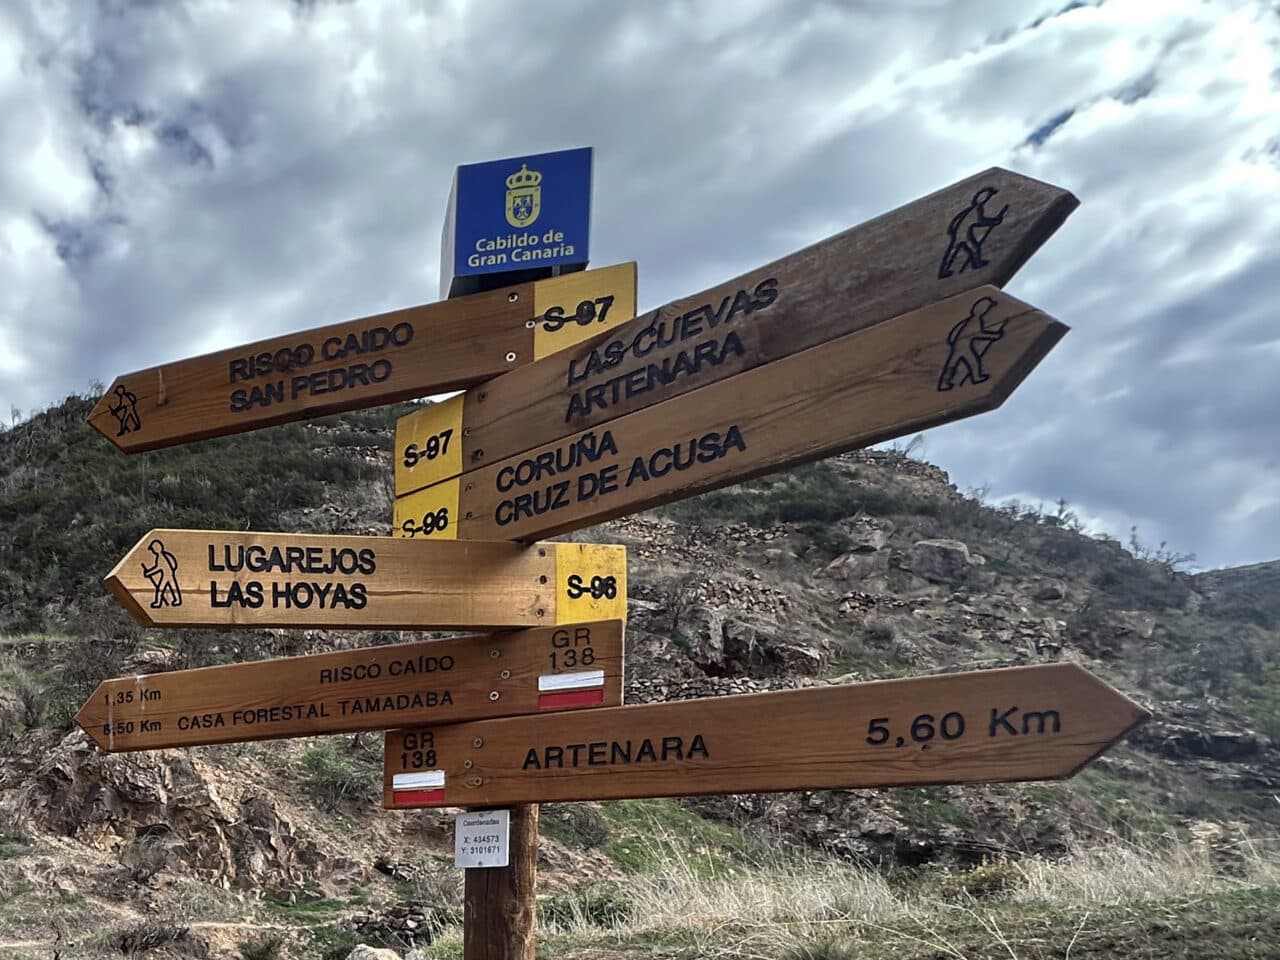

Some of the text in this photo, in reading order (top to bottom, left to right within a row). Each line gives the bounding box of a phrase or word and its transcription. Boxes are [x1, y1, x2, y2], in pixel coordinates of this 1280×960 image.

[468, 244, 574, 267] Gran Canaria
[476, 229, 564, 252] Cabildo de
[568, 278, 778, 387] LAS CUEVAS
[229, 322, 414, 384] RISCO CAIDO
[230, 359, 393, 413] SAN PEDRO
[565, 330, 744, 423] ARTENARA
[404, 429, 453, 468] S-97
[496, 430, 618, 493] CORUÑA
[495, 425, 746, 526] CRUZ DE ACUSA
[208, 544, 376, 575] LUGAREJOS
[210, 580, 368, 609] LAS HOYAS
[567, 575, 617, 599] S-96
[549, 647, 595, 668] 138
[552, 628, 590, 648] GR
[140, 689, 161, 701] Km
[320, 664, 381, 684] RISCO
[389, 656, 455, 676] CAÍDO
[140, 720, 161, 733] Km
[177, 713, 225, 730] CASA
[233, 703, 330, 725] FORESTAL
[338, 690, 454, 716] TAMADABA
[403, 731, 434, 749] GR
[522, 706, 1060, 770] ARTENARA 5,60 Km
[401, 750, 437, 768] 138
